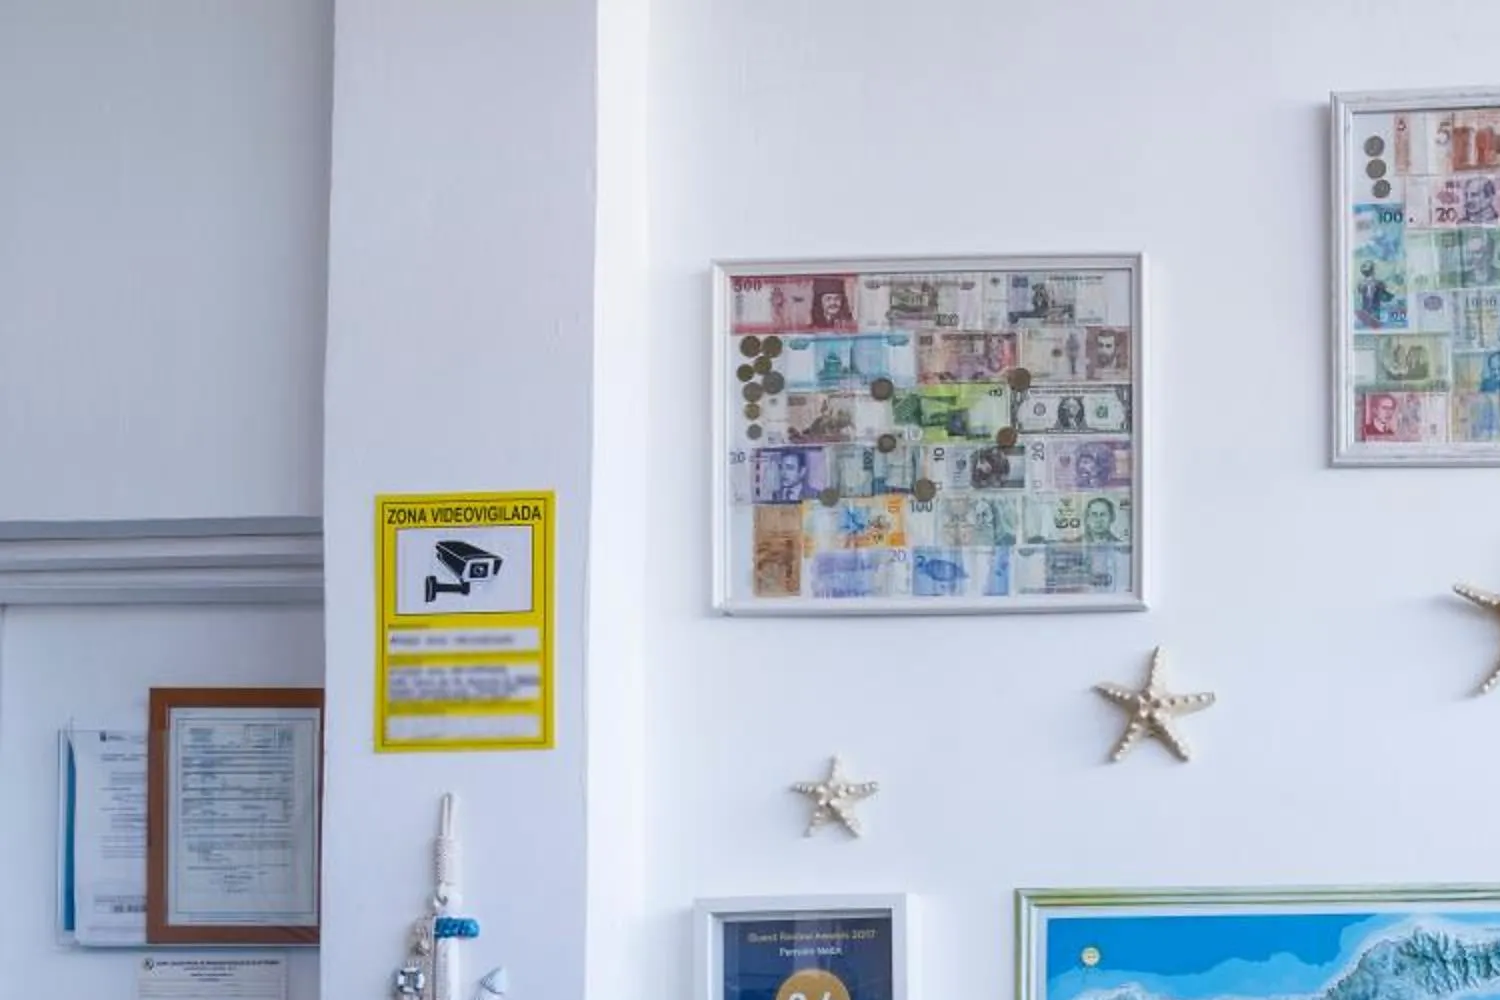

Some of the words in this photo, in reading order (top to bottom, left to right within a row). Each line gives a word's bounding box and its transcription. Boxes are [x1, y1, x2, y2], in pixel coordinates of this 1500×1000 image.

[1436, 207, 1457, 222] 20
[387, 508, 427, 524] ZONA
[431, 505, 542, 523] VIDEOVIGILADA
